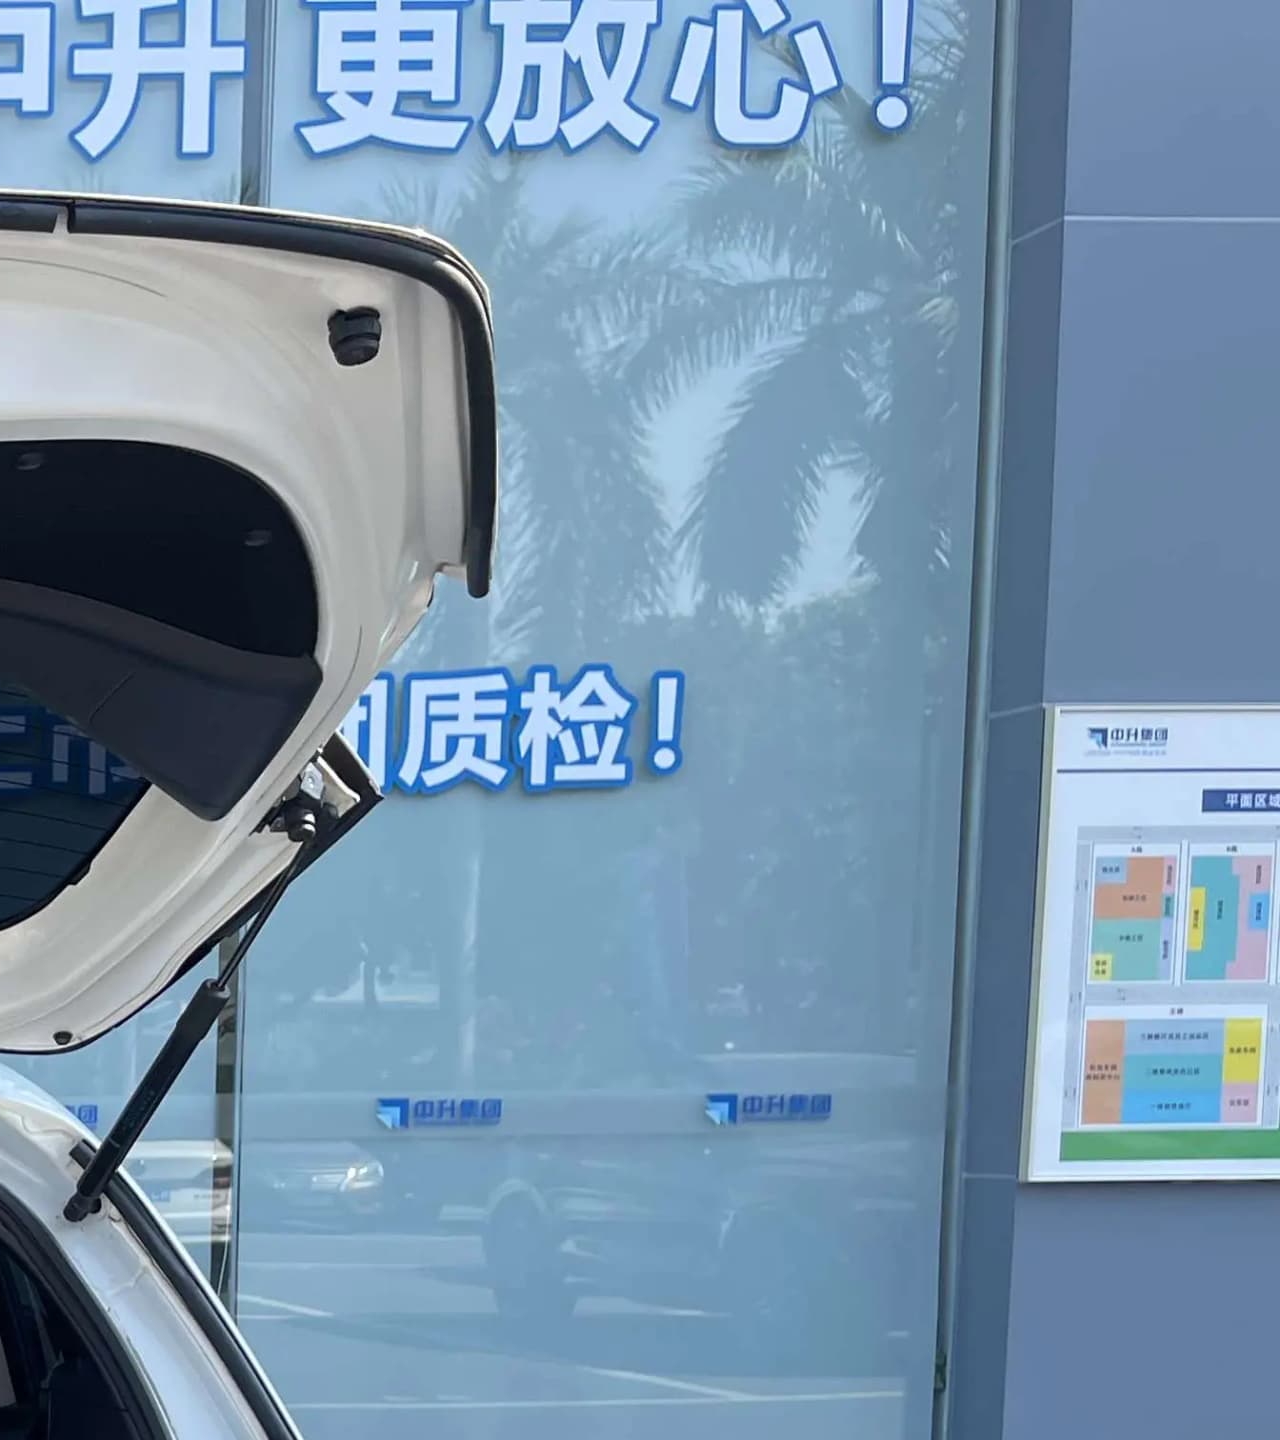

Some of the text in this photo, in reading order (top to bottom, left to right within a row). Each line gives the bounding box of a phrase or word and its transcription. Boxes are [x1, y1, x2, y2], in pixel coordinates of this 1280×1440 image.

[413, 1098, 503, 1119] 中升集团
[742, 1093, 832, 1114] 中升集团
